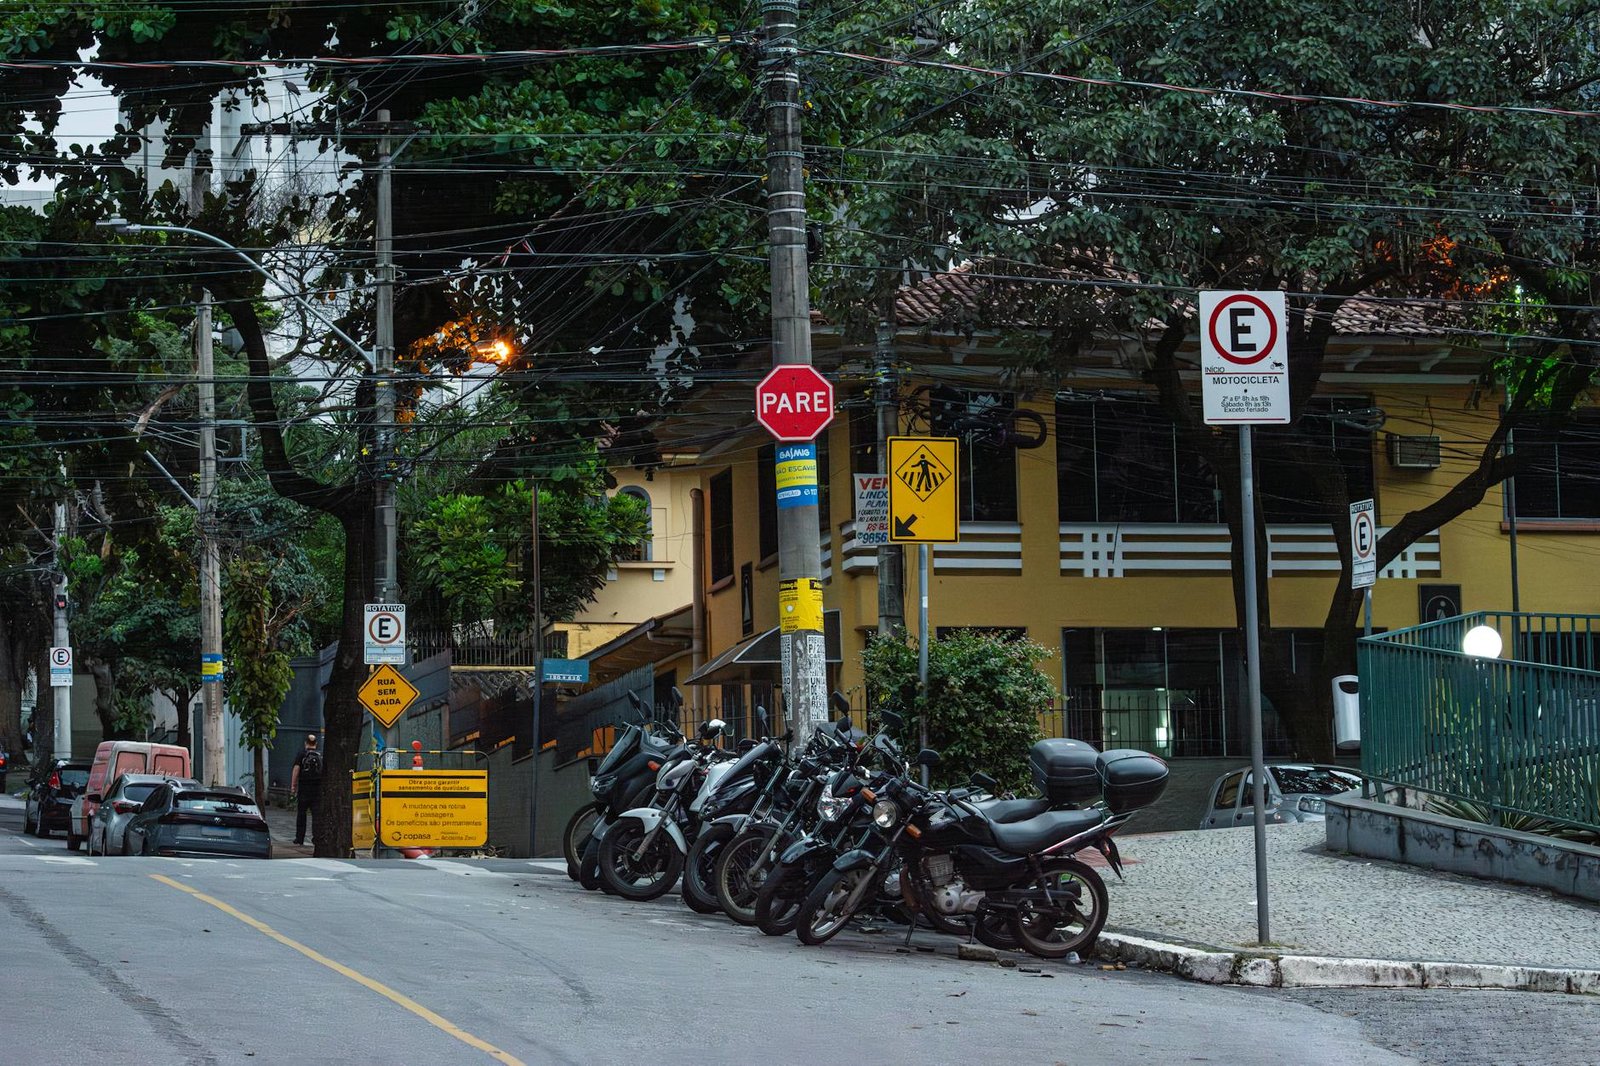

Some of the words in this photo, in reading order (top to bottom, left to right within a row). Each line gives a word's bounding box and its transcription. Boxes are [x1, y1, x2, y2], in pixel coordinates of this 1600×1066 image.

[1229, 307, 1257, 352] E
[1212, 376, 1280, 385] MOTOCICLETA
[762, 391, 828, 414] PARE
[779, 447, 810, 460] GASMIG
[1359, 521, 1368, 552] E
[378, 617, 391, 638] E
[57, 651, 64, 662] E
[374, 698, 402, 706] SAÍDA
[403, 833, 431, 841] copasa
